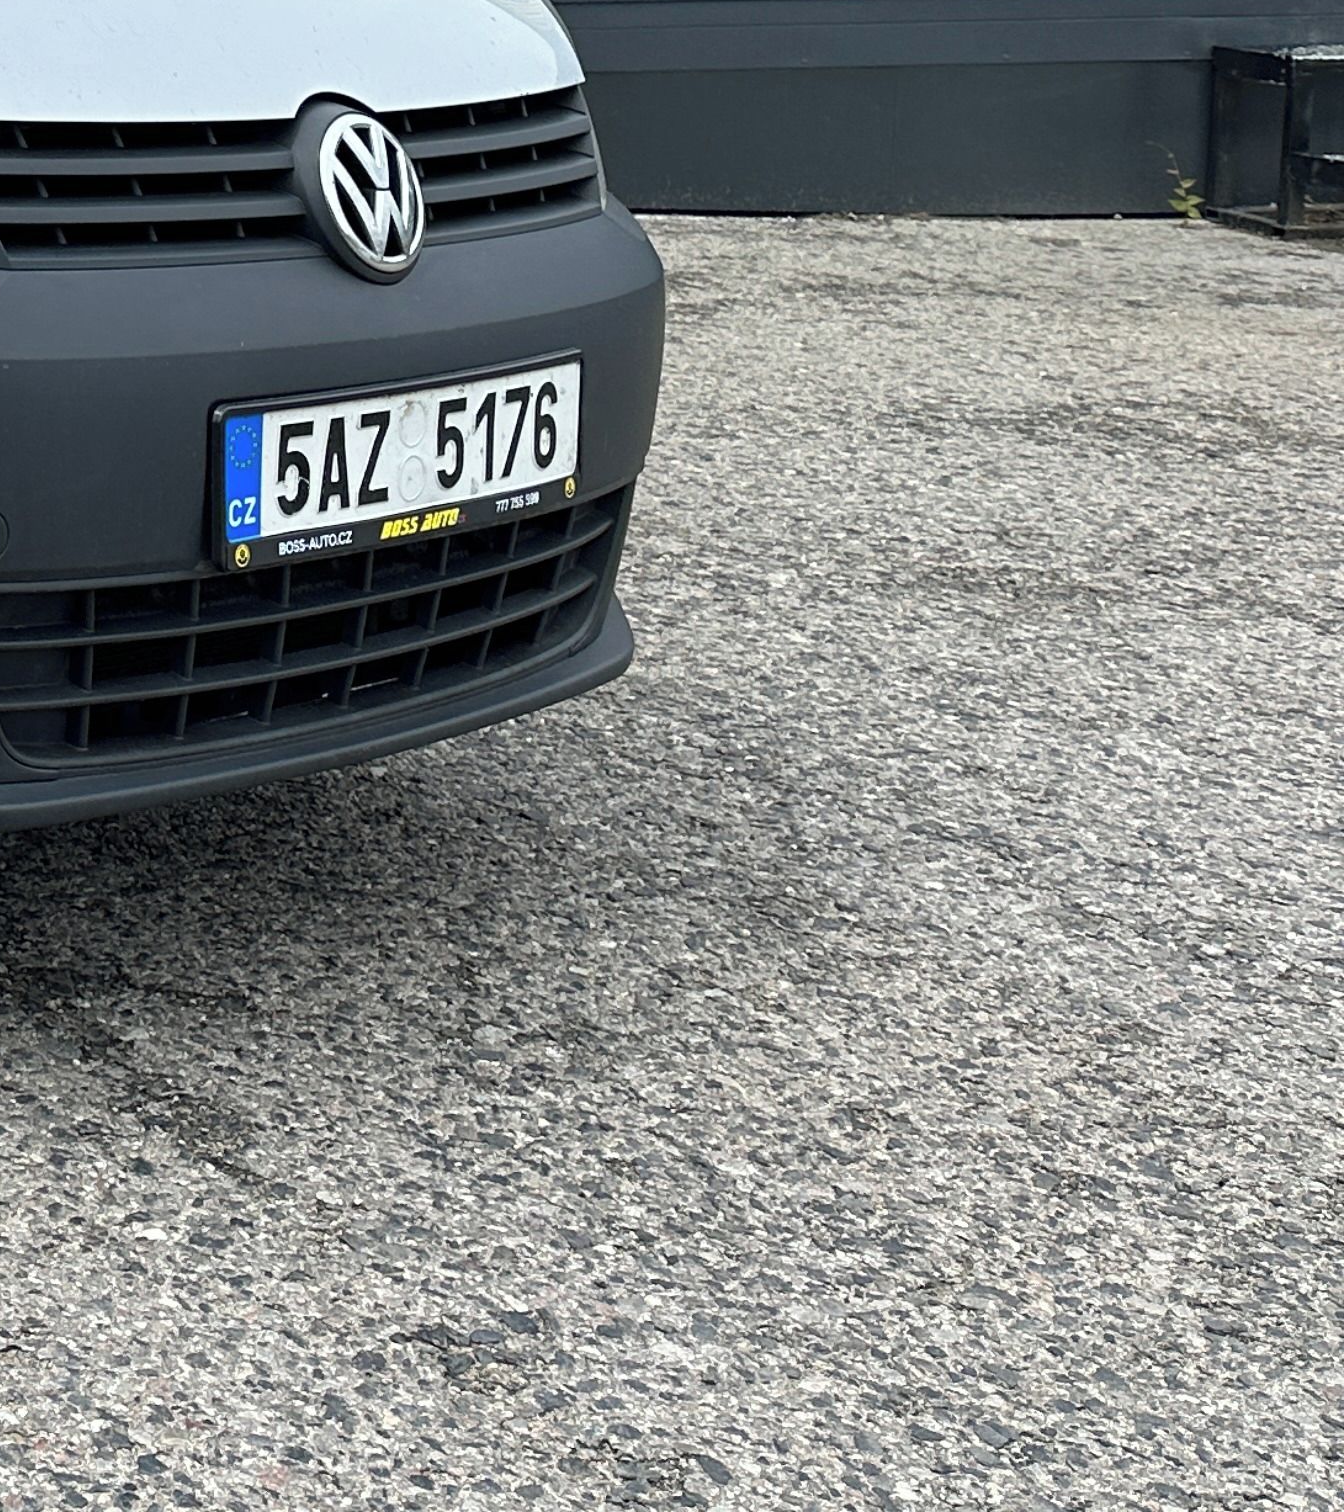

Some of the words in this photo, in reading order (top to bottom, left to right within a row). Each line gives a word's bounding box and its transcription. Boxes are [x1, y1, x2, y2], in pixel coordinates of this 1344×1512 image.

[275, 410, 391, 516] 5AZ
[436, 381, 558, 489] 5176
[228, 496, 257, 528] CZ
[278, 530, 353, 556] BOSS-AUTO.CZ
[380, 516, 419, 540] BOSS
